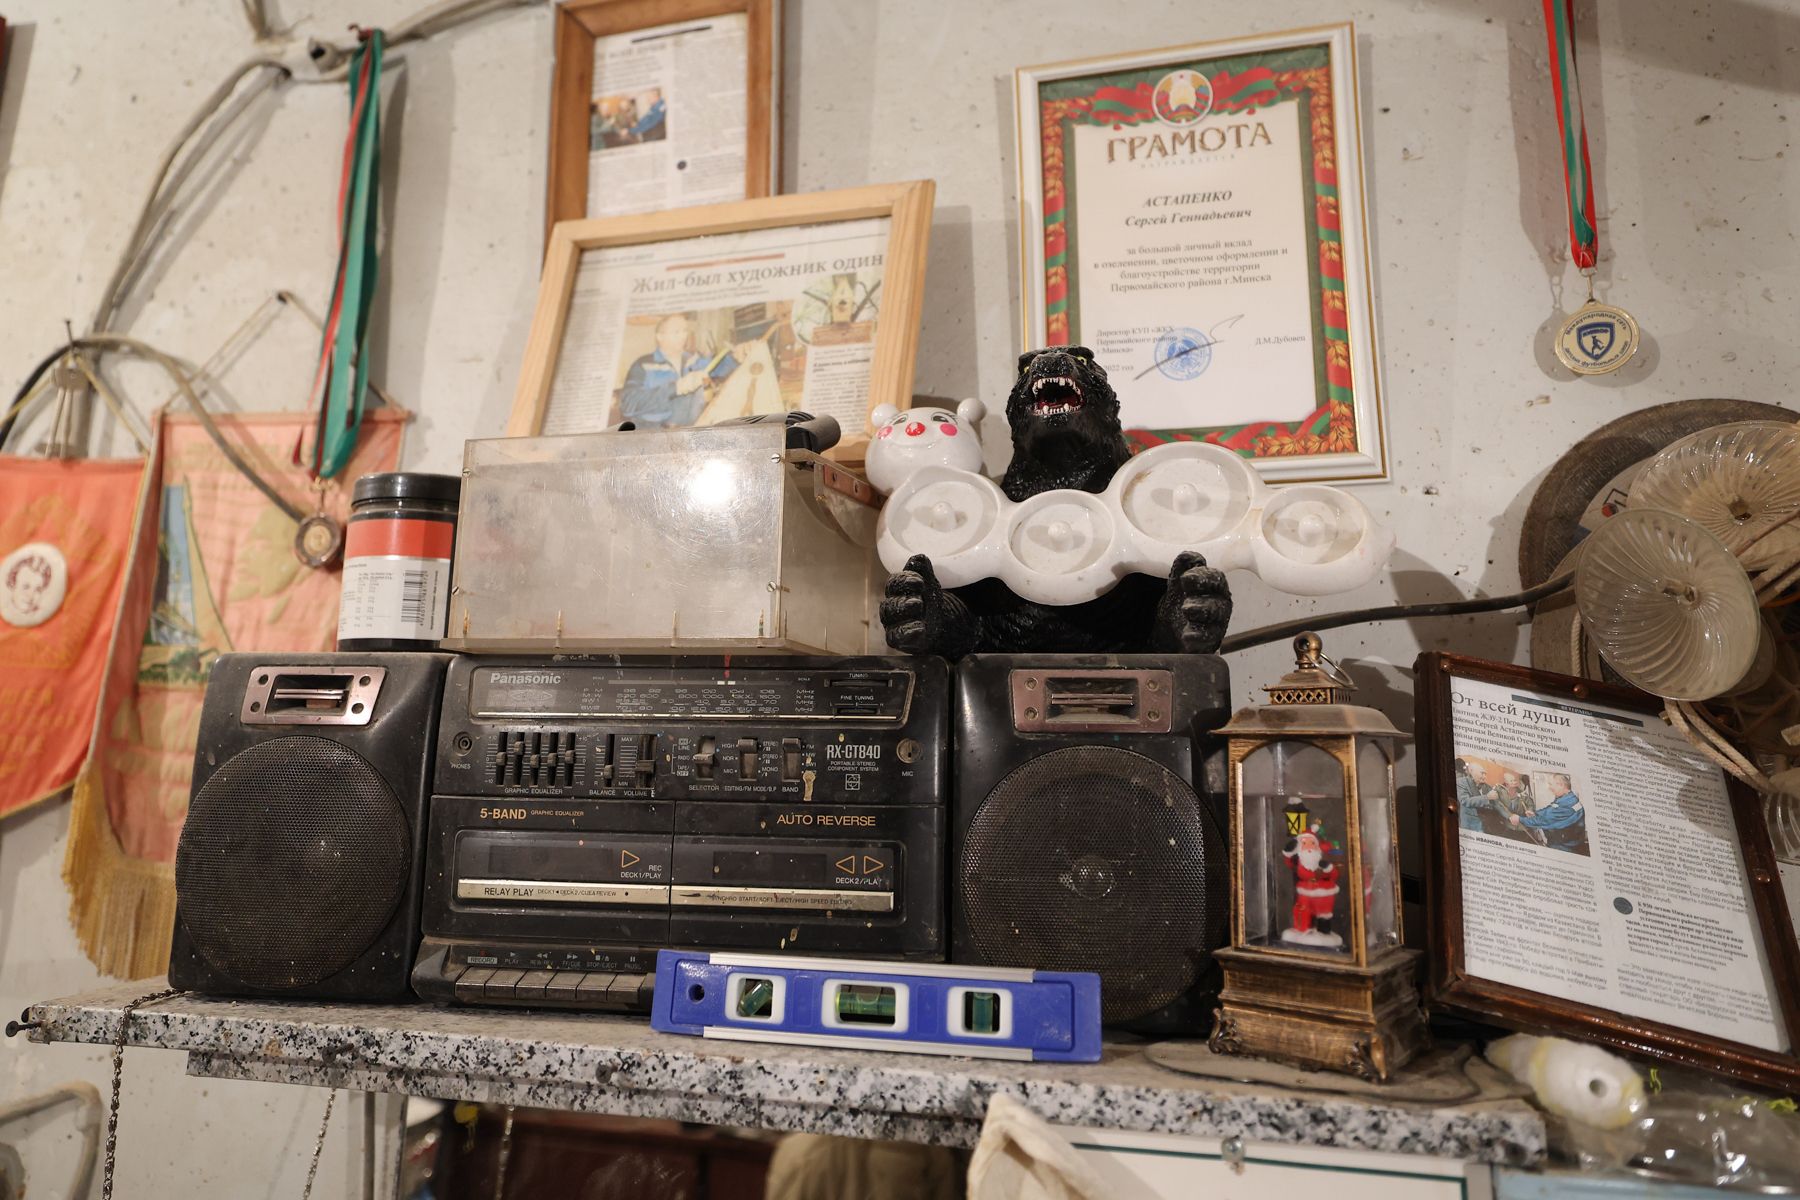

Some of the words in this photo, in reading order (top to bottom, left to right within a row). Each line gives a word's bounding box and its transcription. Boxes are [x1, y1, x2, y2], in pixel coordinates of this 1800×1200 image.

[1107, 122, 1272, 163] ГРАМОТА
[1143, 191, 1232, 208] АСТАПЕНКО
[1125, 213, 1166, 228] Сергей
[1170, 209, 1252, 224] Геннадьевич
[1138, 244, 1182, 254] большой
[1184, 241, 1222, 252] личный
[1224, 238, 1252, 248] вклад
[1102, 258, 1159, 270] озеленении,
[1161, 254, 1214, 266] цветочном
[1216, 248, 1279, 262] оформлении
[1282, 247, 1288, 255] и
[631, 271, 720, 293] Жил-был
[727, 263, 826, 287] художник
[833, 254, 884, 271] один
[1120, 268, 1200, 280] благоустройстве
[1204, 264, 1261, 275] территории
[1111, 280, 1186, 293] Первомайского
[1188, 276, 1222, 289] района
[1225, 274, 1272, 286] г.Минска
[490, 672, 561, 684] Panasonic
[1451, 691, 1473, 706] От
[1478, 701, 1517, 716] всей
[1521, 709, 1571, 727] души
[1475, 719, 1497, 730] Сергей
[1499, 725, 1535, 738] Астапенко
[1536, 733, 1561, 743] вручил
[1503, 718, 1556, 734] Первомайского
[1454, 731, 1472, 740] ойны
[1474, 736, 1523, 751] оригинальные
[1524, 747, 1550, 757] трости,
[1487, 730, 1515, 741] Великой
[1516, 736, 1568, 752] Отечественной
[826, 744, 880, 760] RX-CT840
[1488, 745, 1538, 761] собственными
[1539, 758, 1566, 770] руками
[480, 808, 527, 820] 5-BAND
[776, 814, 813, 825] AUTO
[816, 816, 876, 827] REVERSE
[484, 887, 511, 896] RELAY
[513, 888, 534, 896] PLAY
